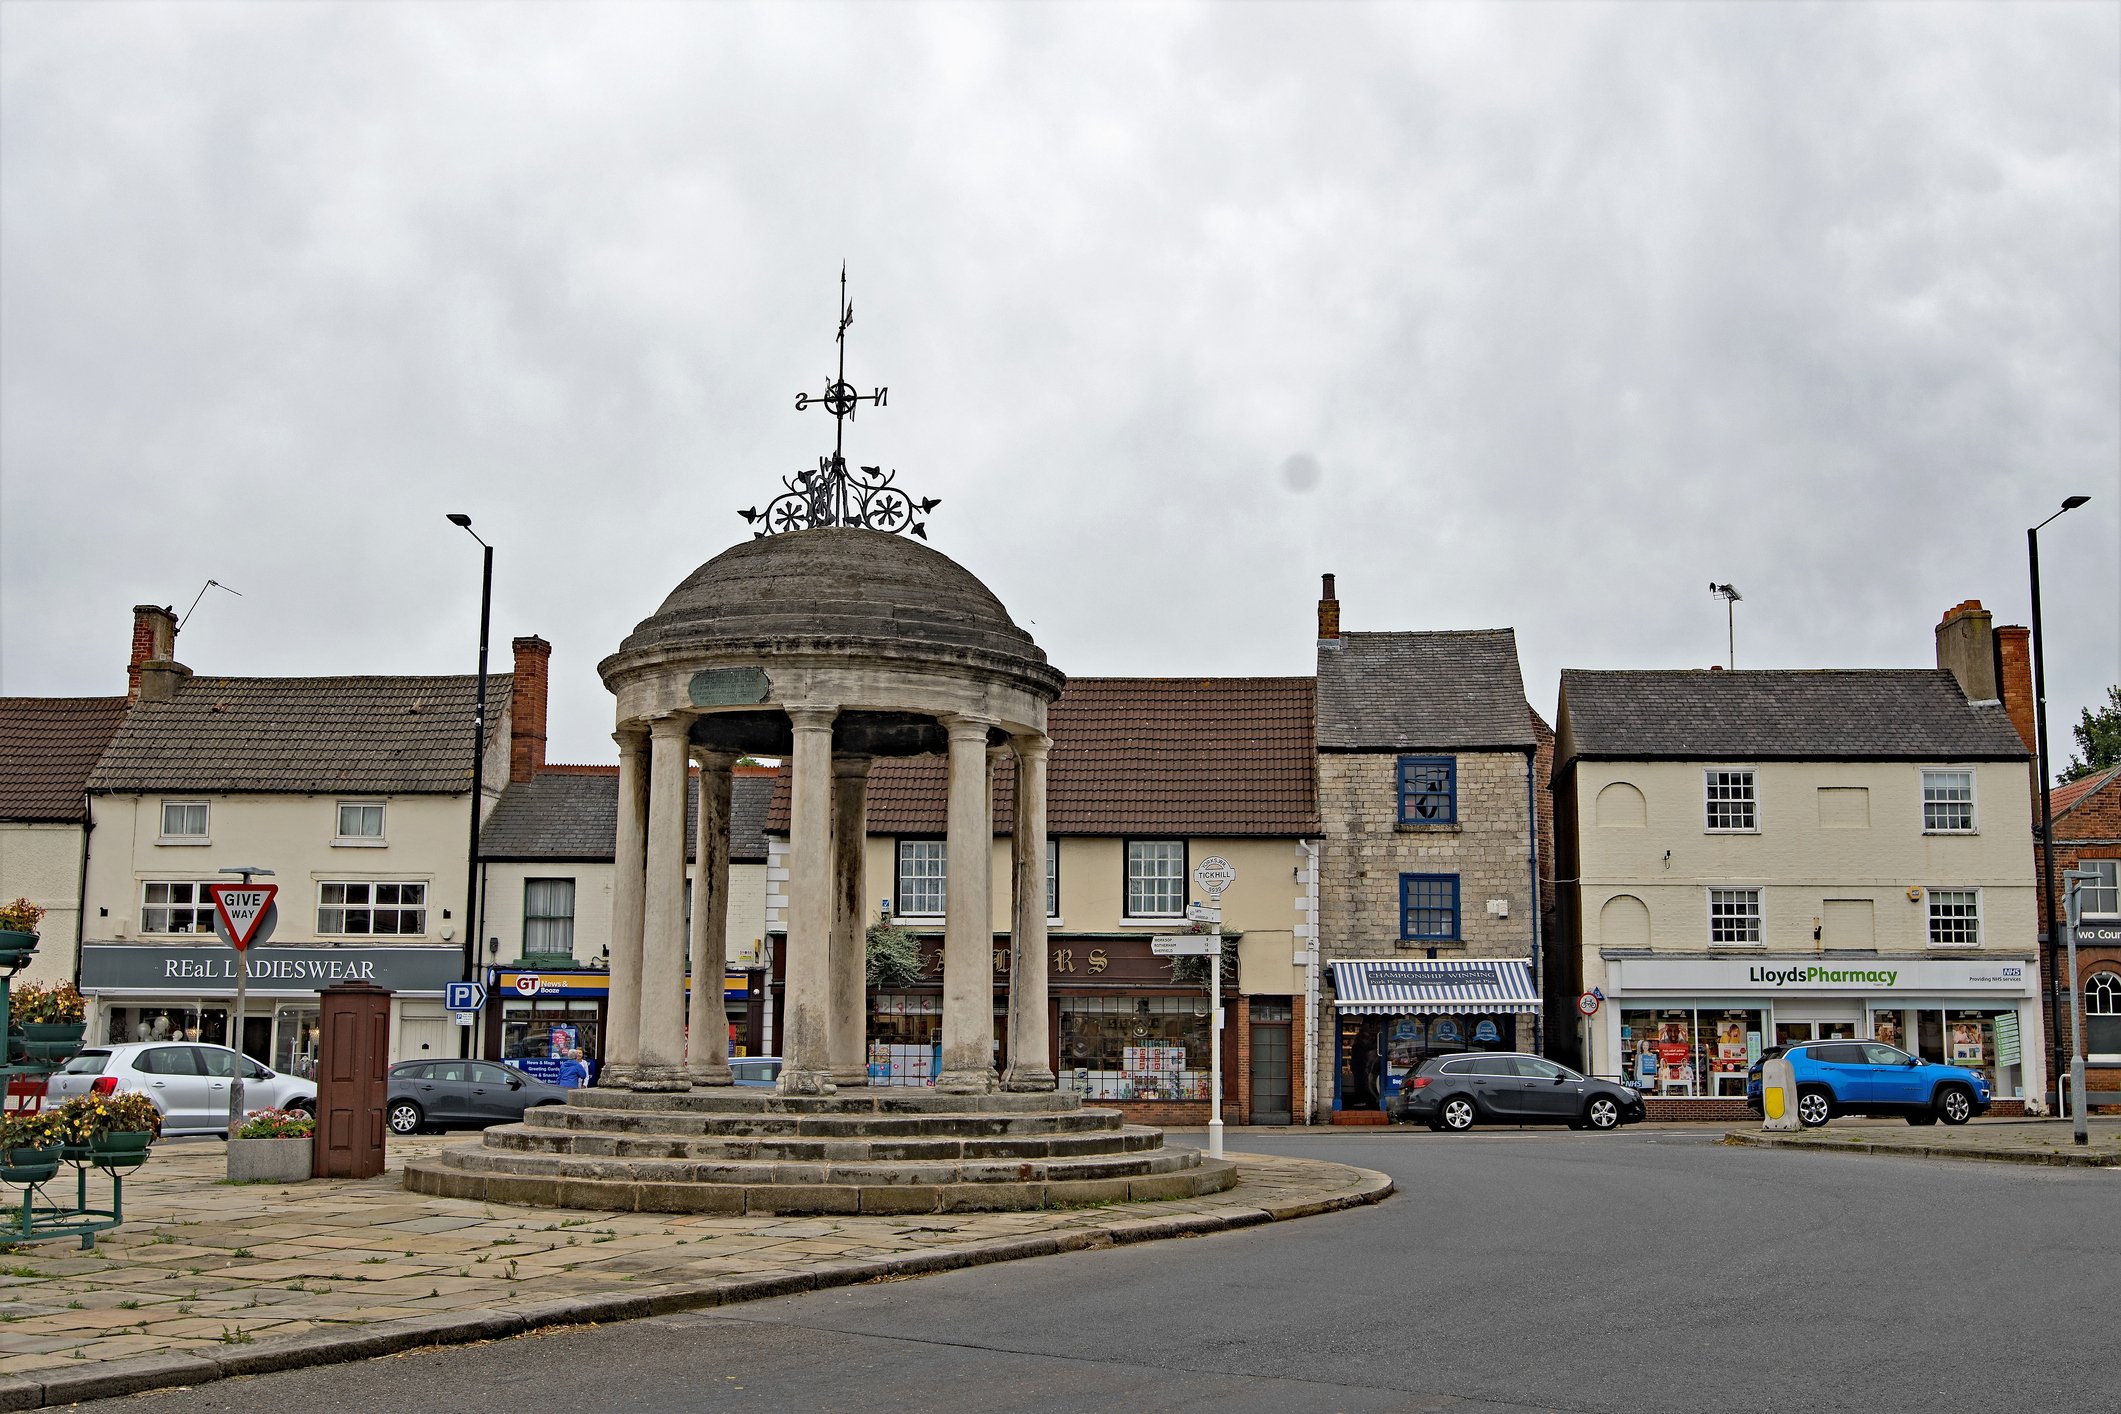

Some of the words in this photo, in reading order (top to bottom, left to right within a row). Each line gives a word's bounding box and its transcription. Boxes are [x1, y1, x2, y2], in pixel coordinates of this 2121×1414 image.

[1198, 871, 1231, 879] TICKHILL
[224, 893, 261, 907] GIVE
[231, 910, 255, 919] WAY
[164, 959, 219, 978] REaL
[223, 960, 376, 979] LADIESWEAR
[2003, 968, 2021, 976] NHS
[1750, 966, 1897, 987] LloydsPharmacy
[517, 977, 539, 990] GT
[454, 987, 470, 1006] P
